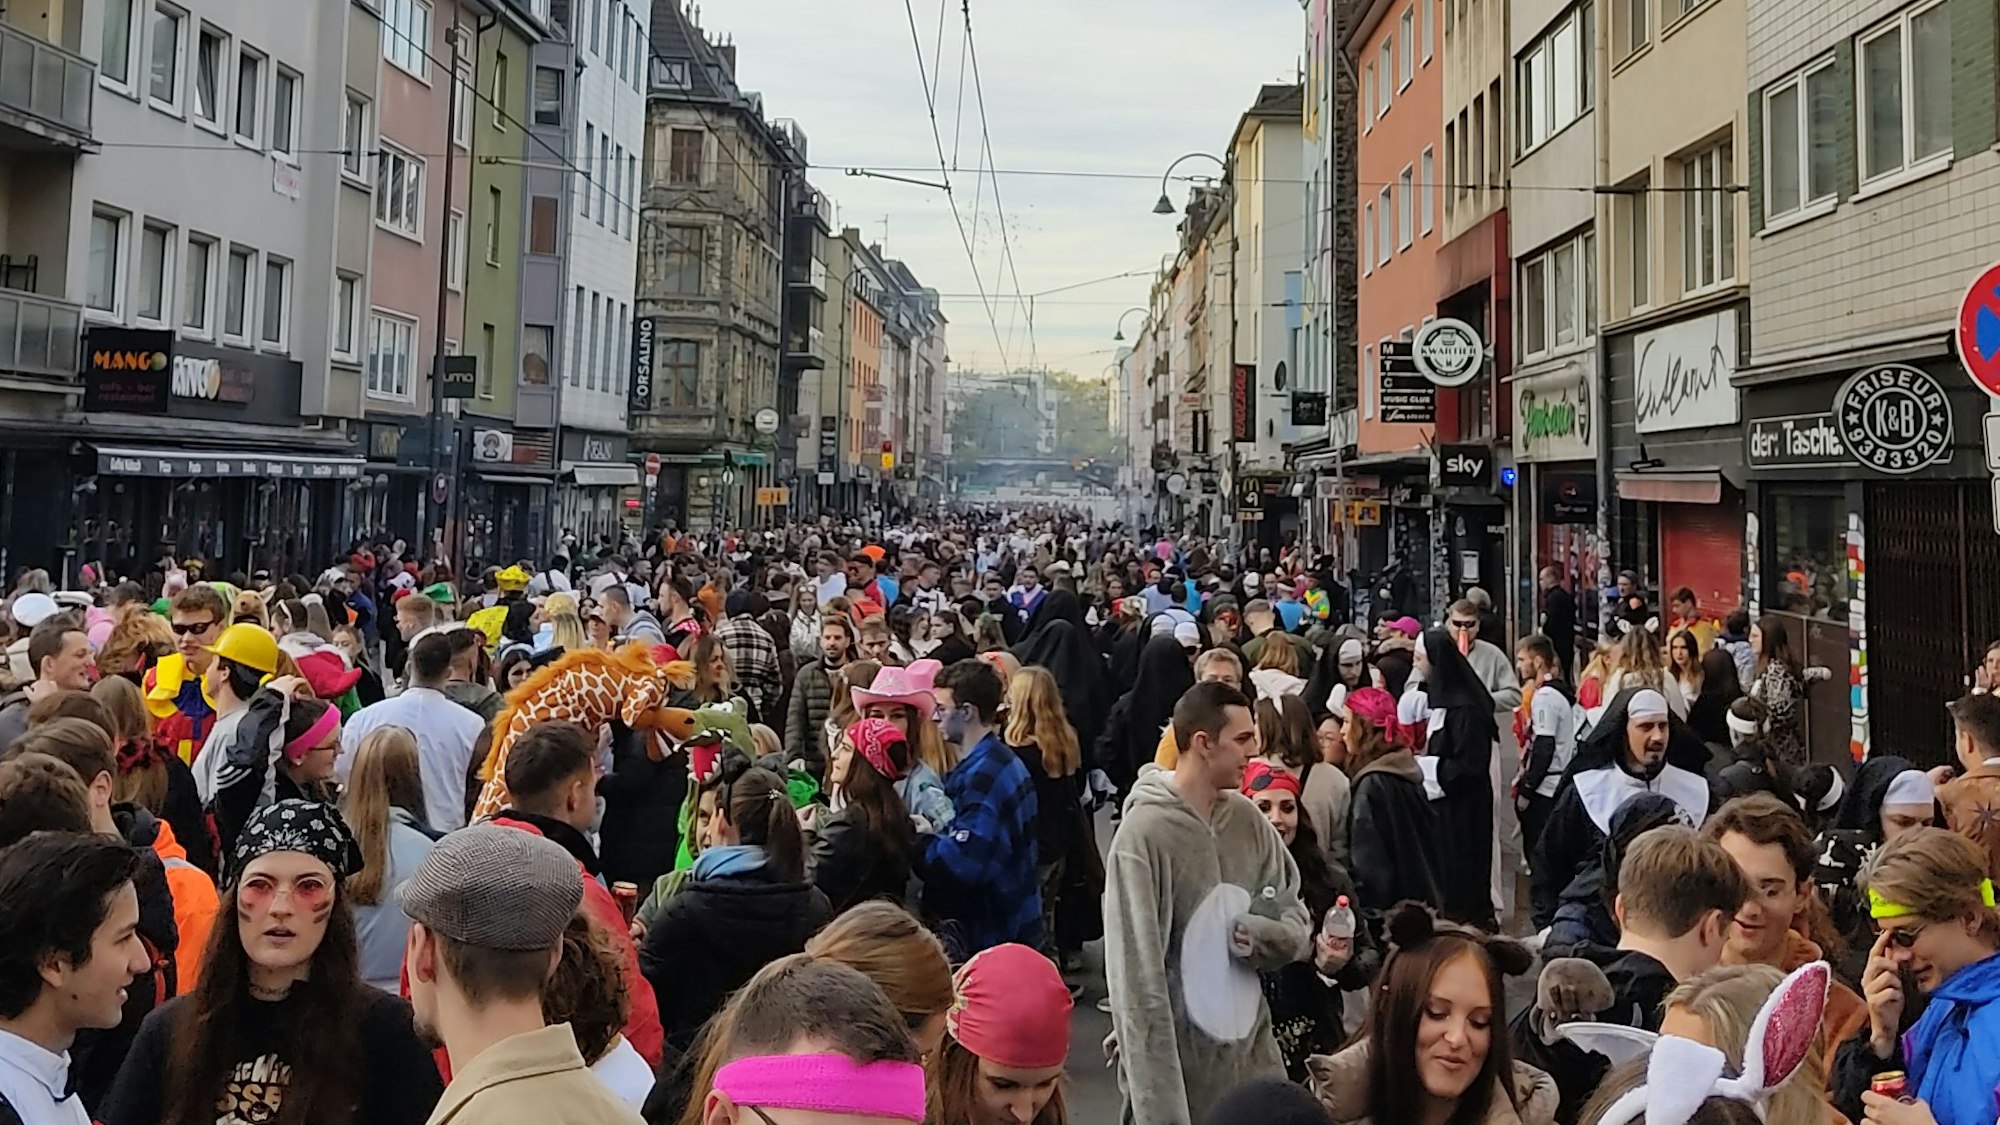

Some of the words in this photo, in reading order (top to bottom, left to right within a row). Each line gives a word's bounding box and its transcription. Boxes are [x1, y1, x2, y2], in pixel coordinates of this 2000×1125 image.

[1383, 344, 1394, 355] M
[93, 350, 168, 372] MANGO
[1384, 360, 1393, 371] T
[1383, 377, 1393, 388] C
[1846, 369, 1942, 411] FRISEUR
[1875, 399, 1914, 438] K&B
[1848, 428, 1943, 468] 9383320
[1446, 454, 1483, 477] sky
